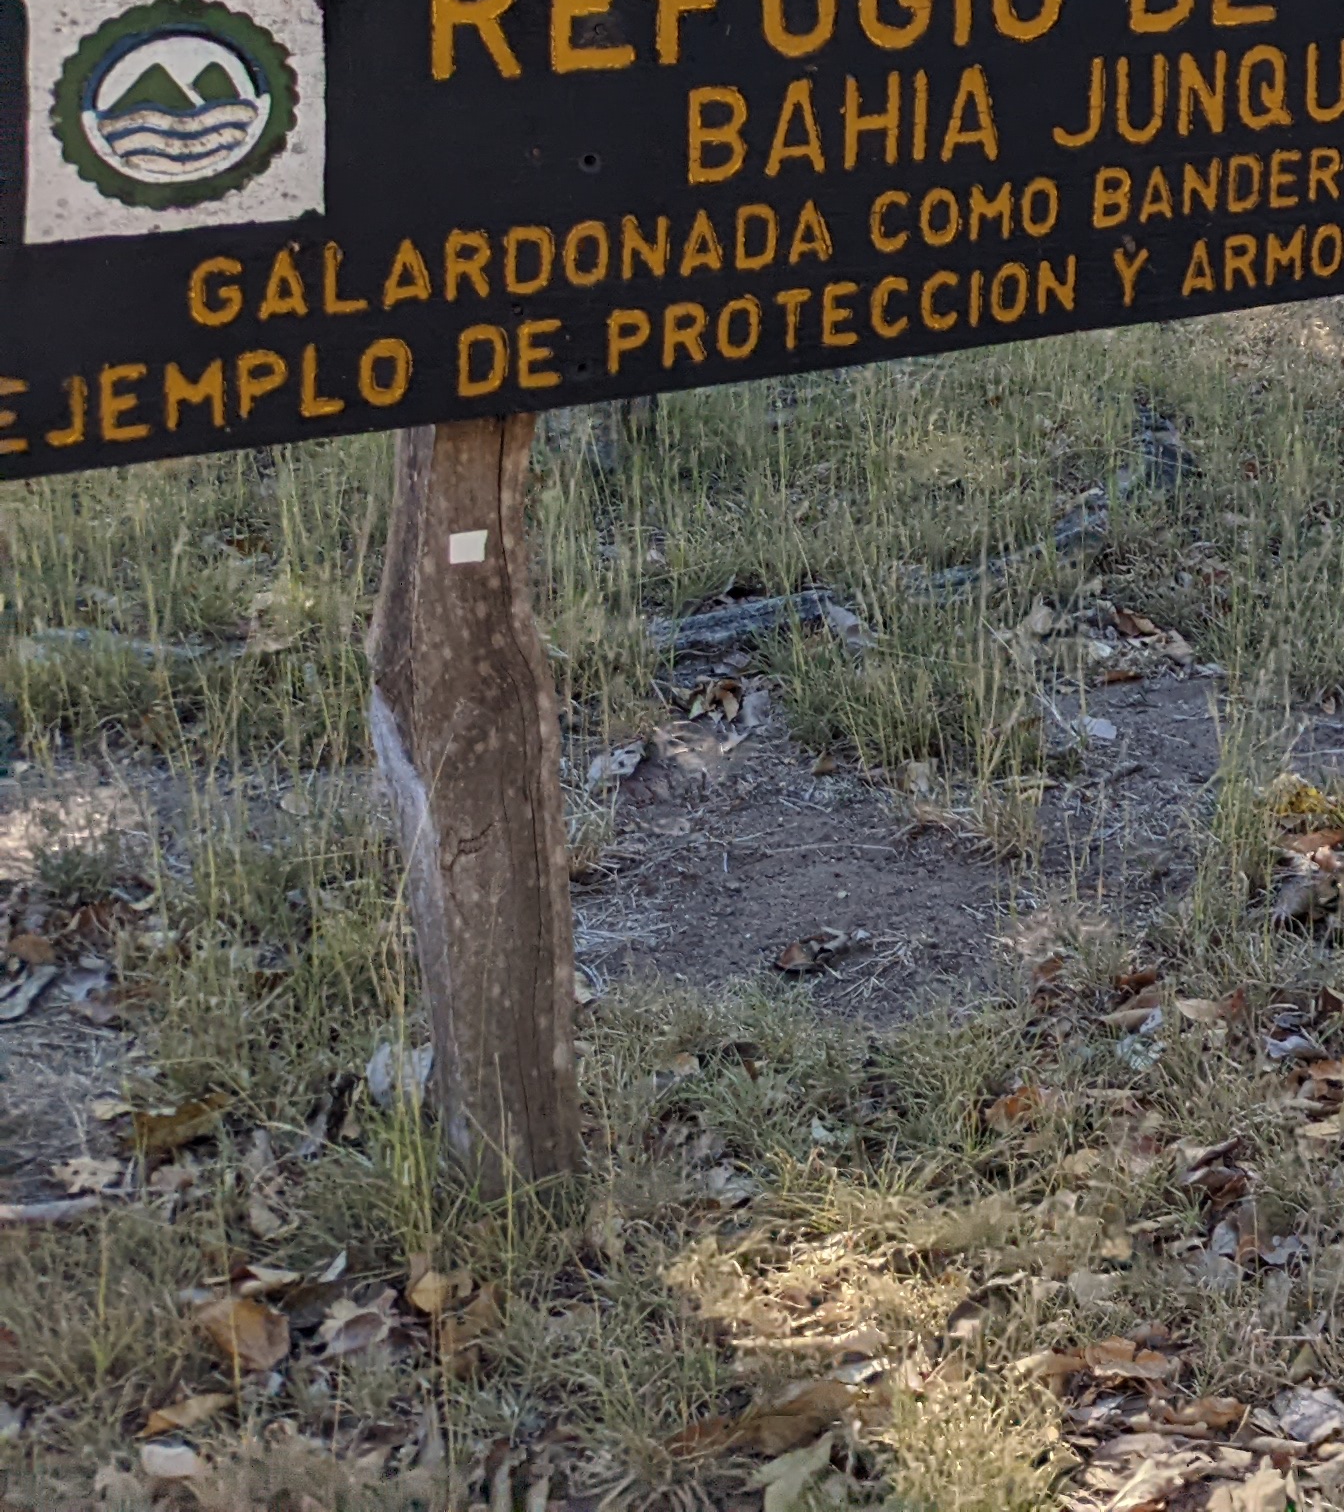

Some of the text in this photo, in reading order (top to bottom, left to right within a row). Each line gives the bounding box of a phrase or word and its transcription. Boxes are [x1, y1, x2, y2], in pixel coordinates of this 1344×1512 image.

[686, 65, 999, 186] BAHIA
[187, 199, 834, 328] GALARDONADA
[869, 176, 1060, 254] COMO
[0, 336, 414, 455] EJEMPLO
[456, 318, 562, 398] DE
[606, 255, 1077, 375] PROTECCION
[1112, 248, 1150, 307] Y
